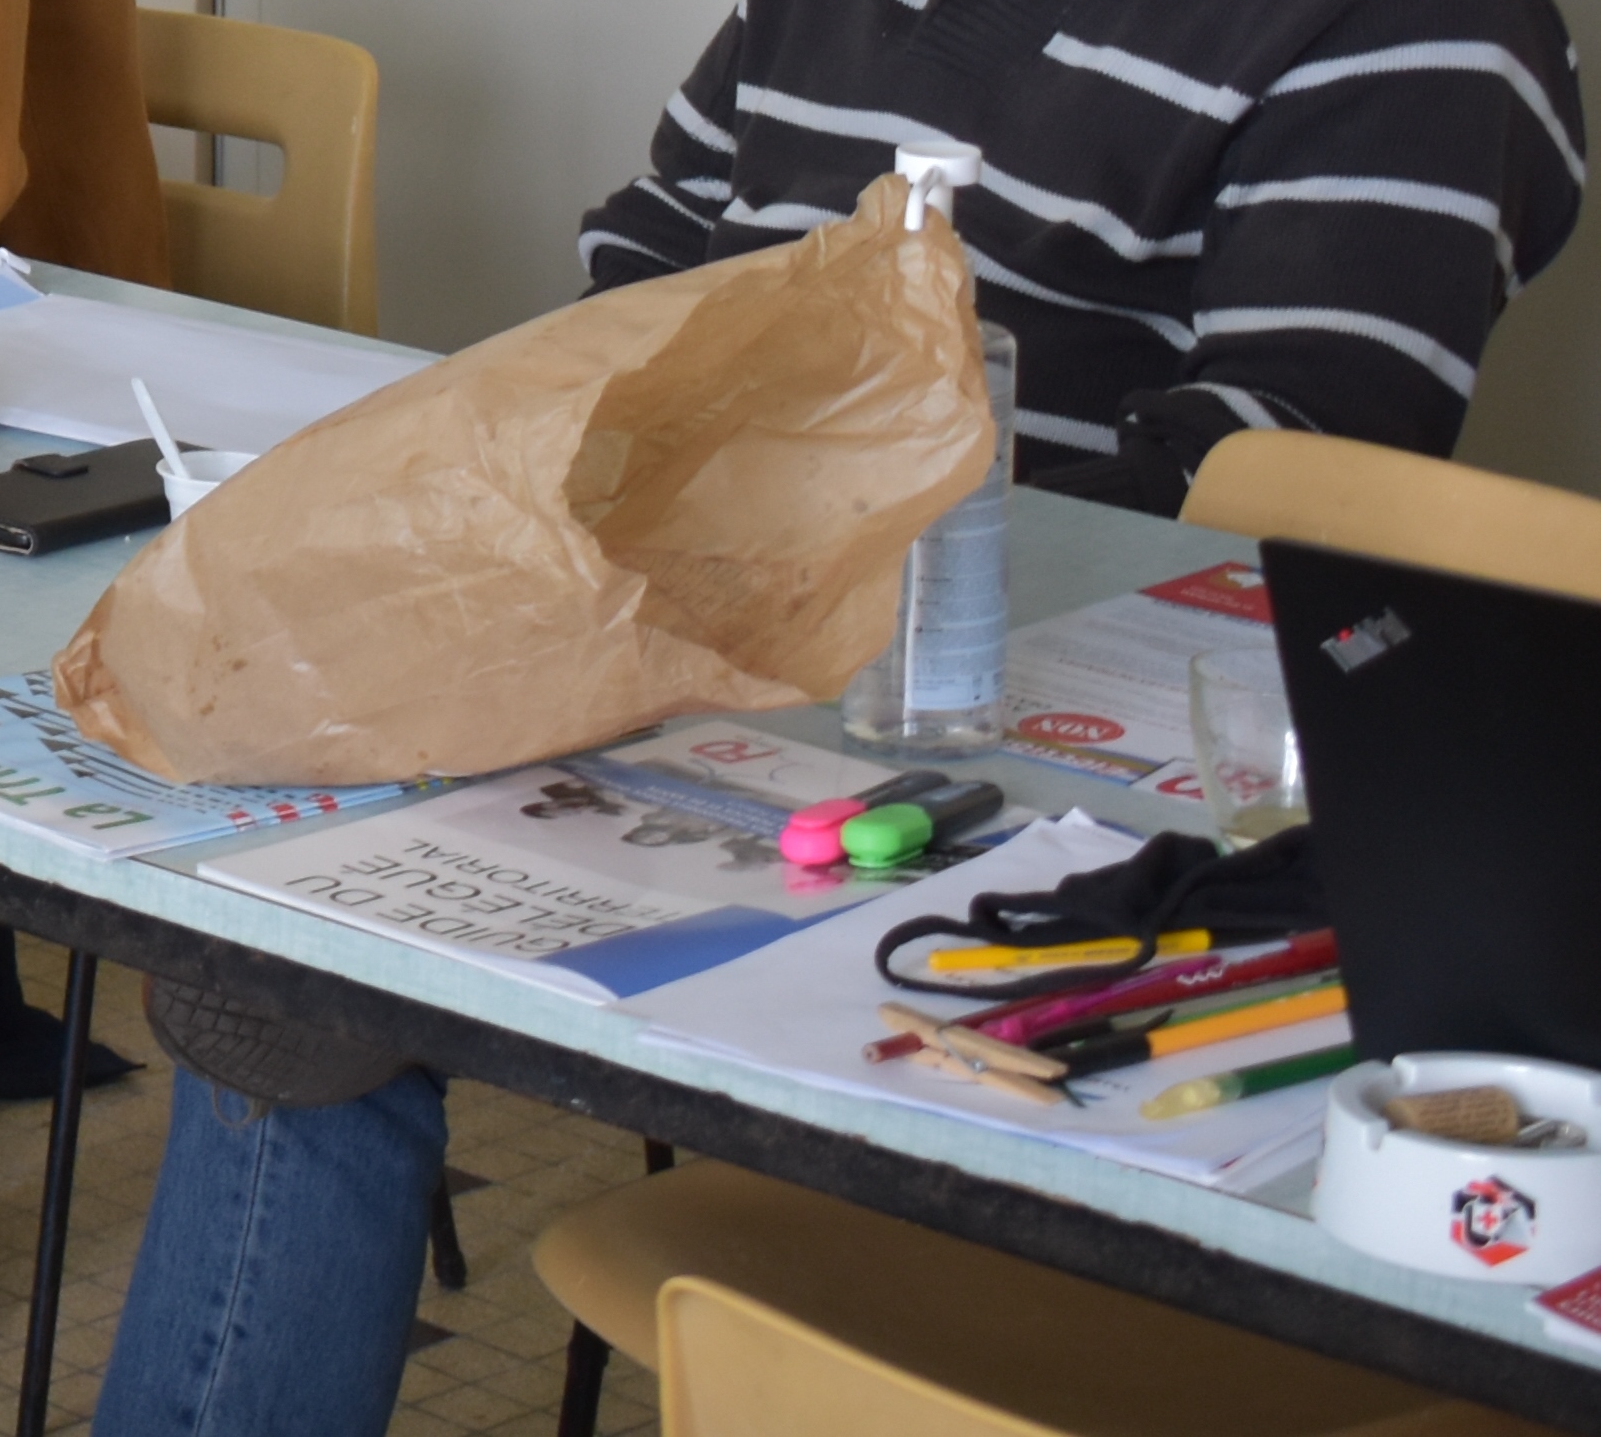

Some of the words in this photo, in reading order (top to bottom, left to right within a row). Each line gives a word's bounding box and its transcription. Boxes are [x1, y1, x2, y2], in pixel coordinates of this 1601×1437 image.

[63, 802, 154, 830] La
[285, 874, 387, 906] DU
[341, 853, 636, 938] DÉLÉGUÉ
[401, 837, 681, 922] TERRITORIAL
[375, 901, 571, 953] GUIDE
